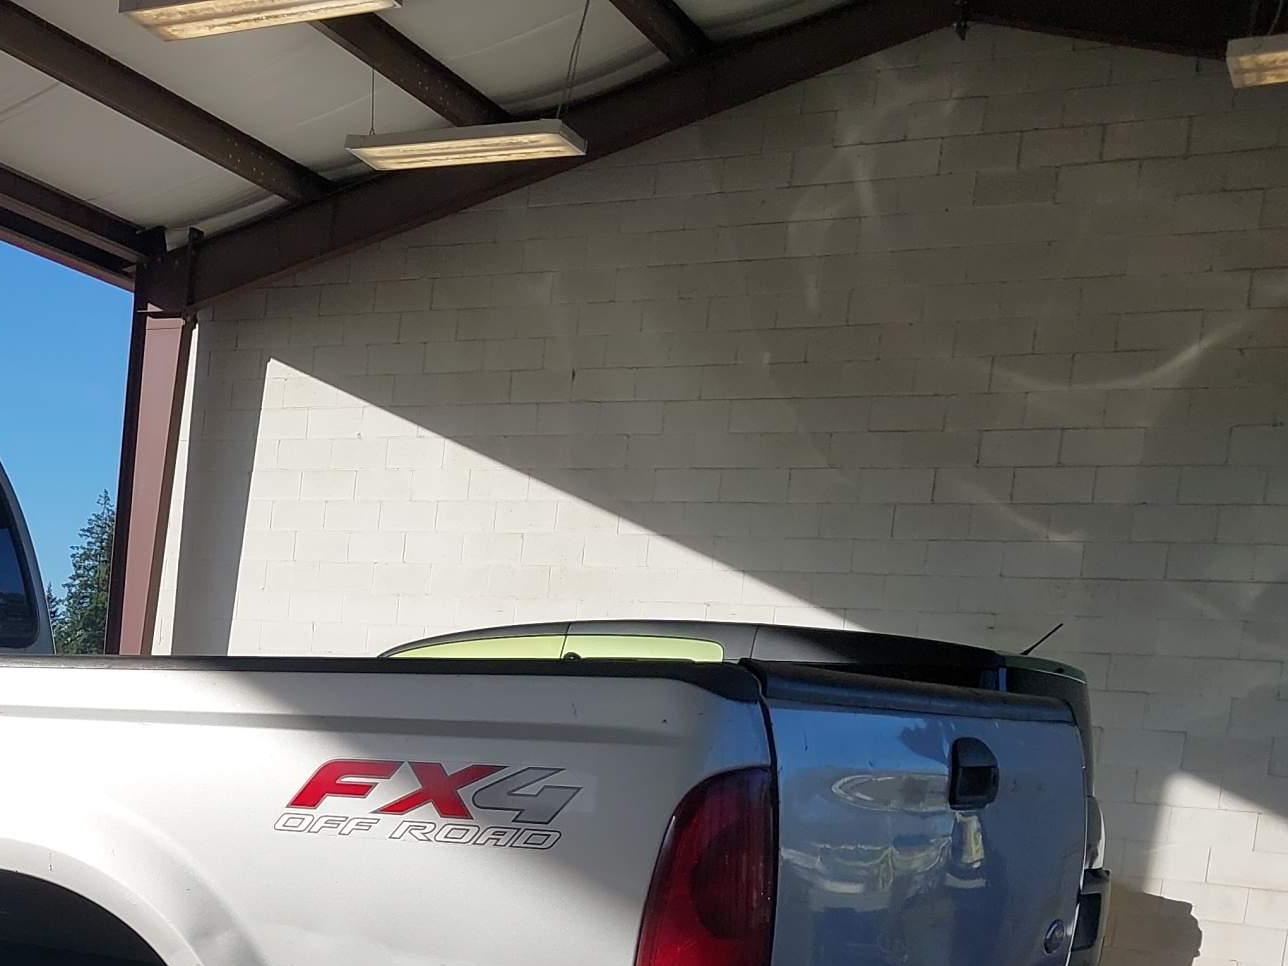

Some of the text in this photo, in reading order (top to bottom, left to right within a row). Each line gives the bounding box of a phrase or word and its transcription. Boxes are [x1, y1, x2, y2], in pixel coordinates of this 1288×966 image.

[284, 757, 583, 825] FX4
[274, 812, 562, 850] OFF ROAD
